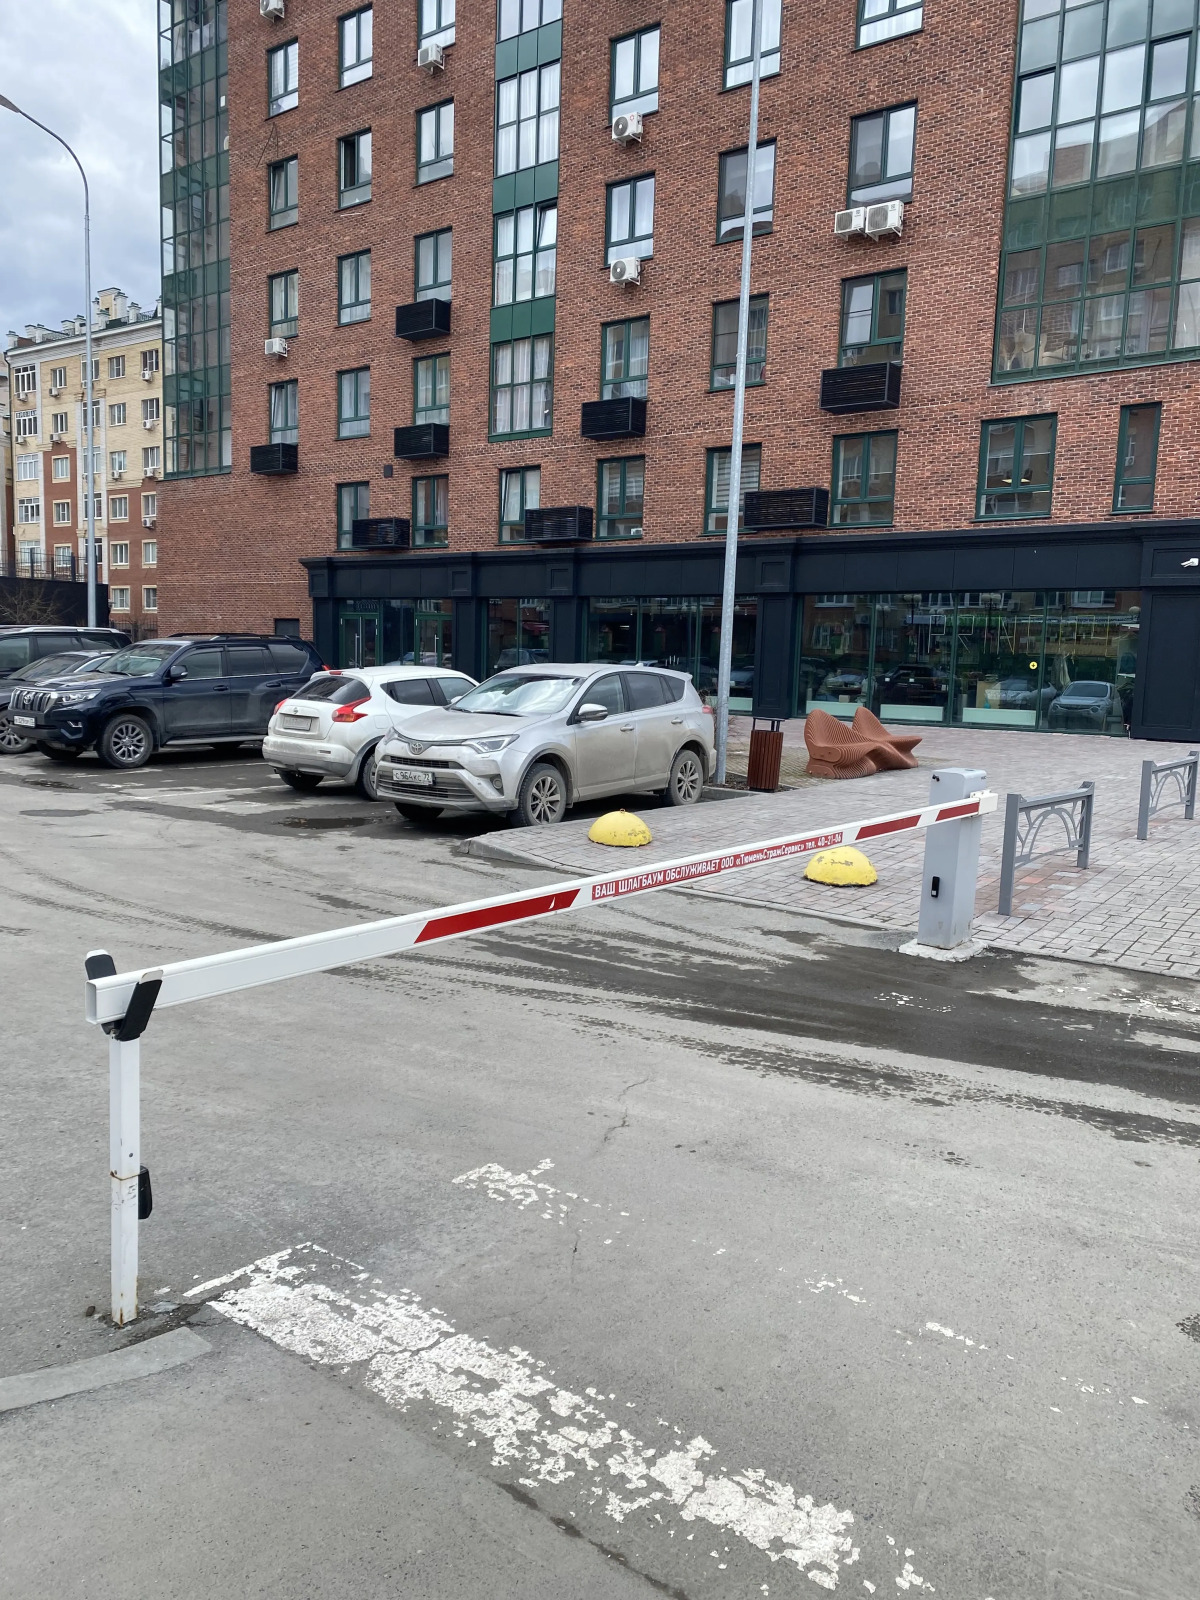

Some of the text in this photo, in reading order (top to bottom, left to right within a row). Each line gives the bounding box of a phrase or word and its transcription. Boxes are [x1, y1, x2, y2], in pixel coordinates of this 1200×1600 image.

[594, 884, 616, 898] ВАШ
[618, 872, 664, 893] ШЛАГБАУМ
[665, 859, 720, 882] ОБСЛУЖИВАЕТ
[721, 856, 735, 869] ООО
[805, 841, 817, 850] тел.
